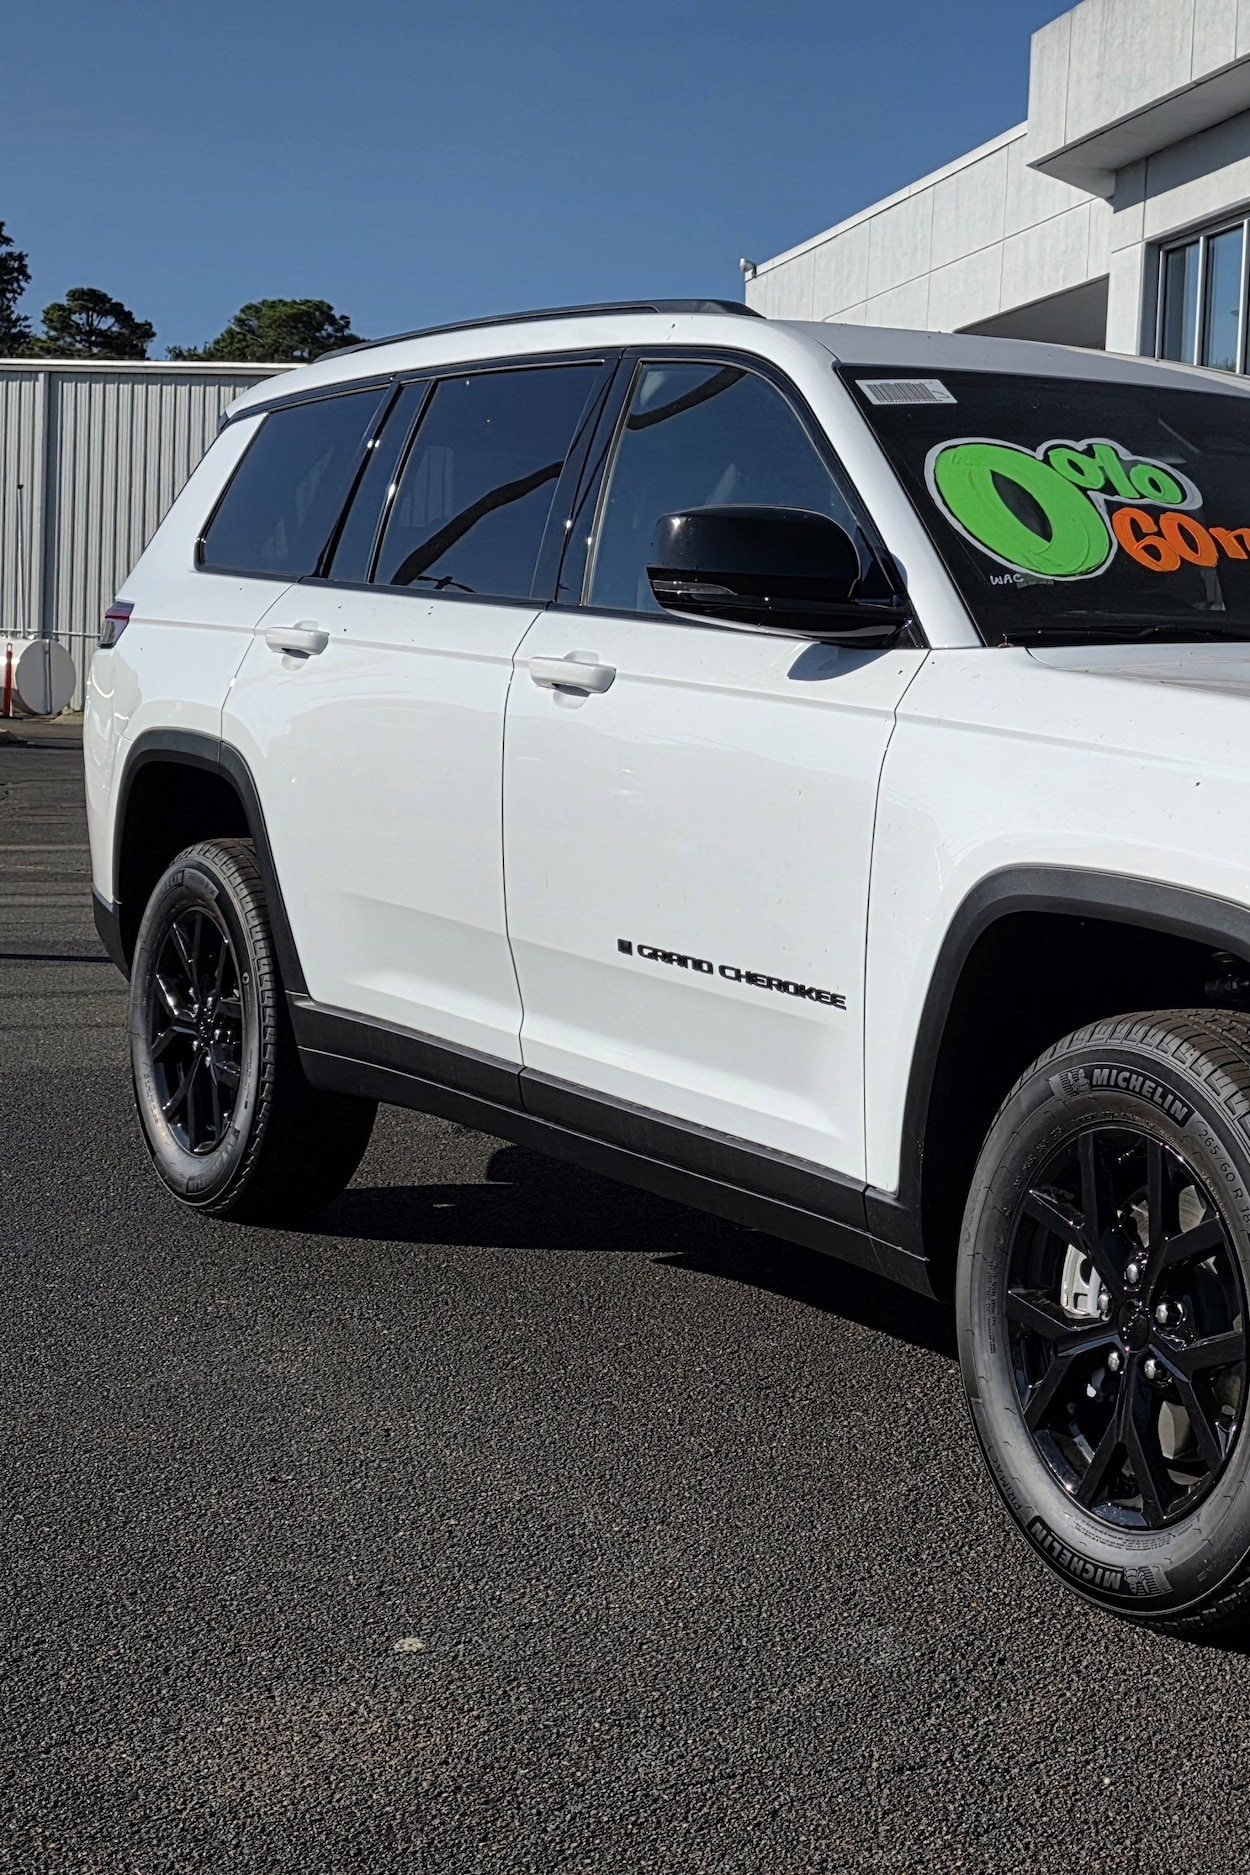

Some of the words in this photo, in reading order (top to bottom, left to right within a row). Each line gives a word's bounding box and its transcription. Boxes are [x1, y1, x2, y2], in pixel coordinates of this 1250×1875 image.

[989, 573, 1024, 586] WAC
[636, 943, 714, 975] GRAND
[718, 964, 848, 1011] CHEROKEE
[1092, 1068, 1188, 1122] MICHELIN
[1198, 1129, 1236, 1182] 265/60
[1232, 1188, 1244, 1199] R
[1030, 1521, 1123, 1591] MICHELIN
